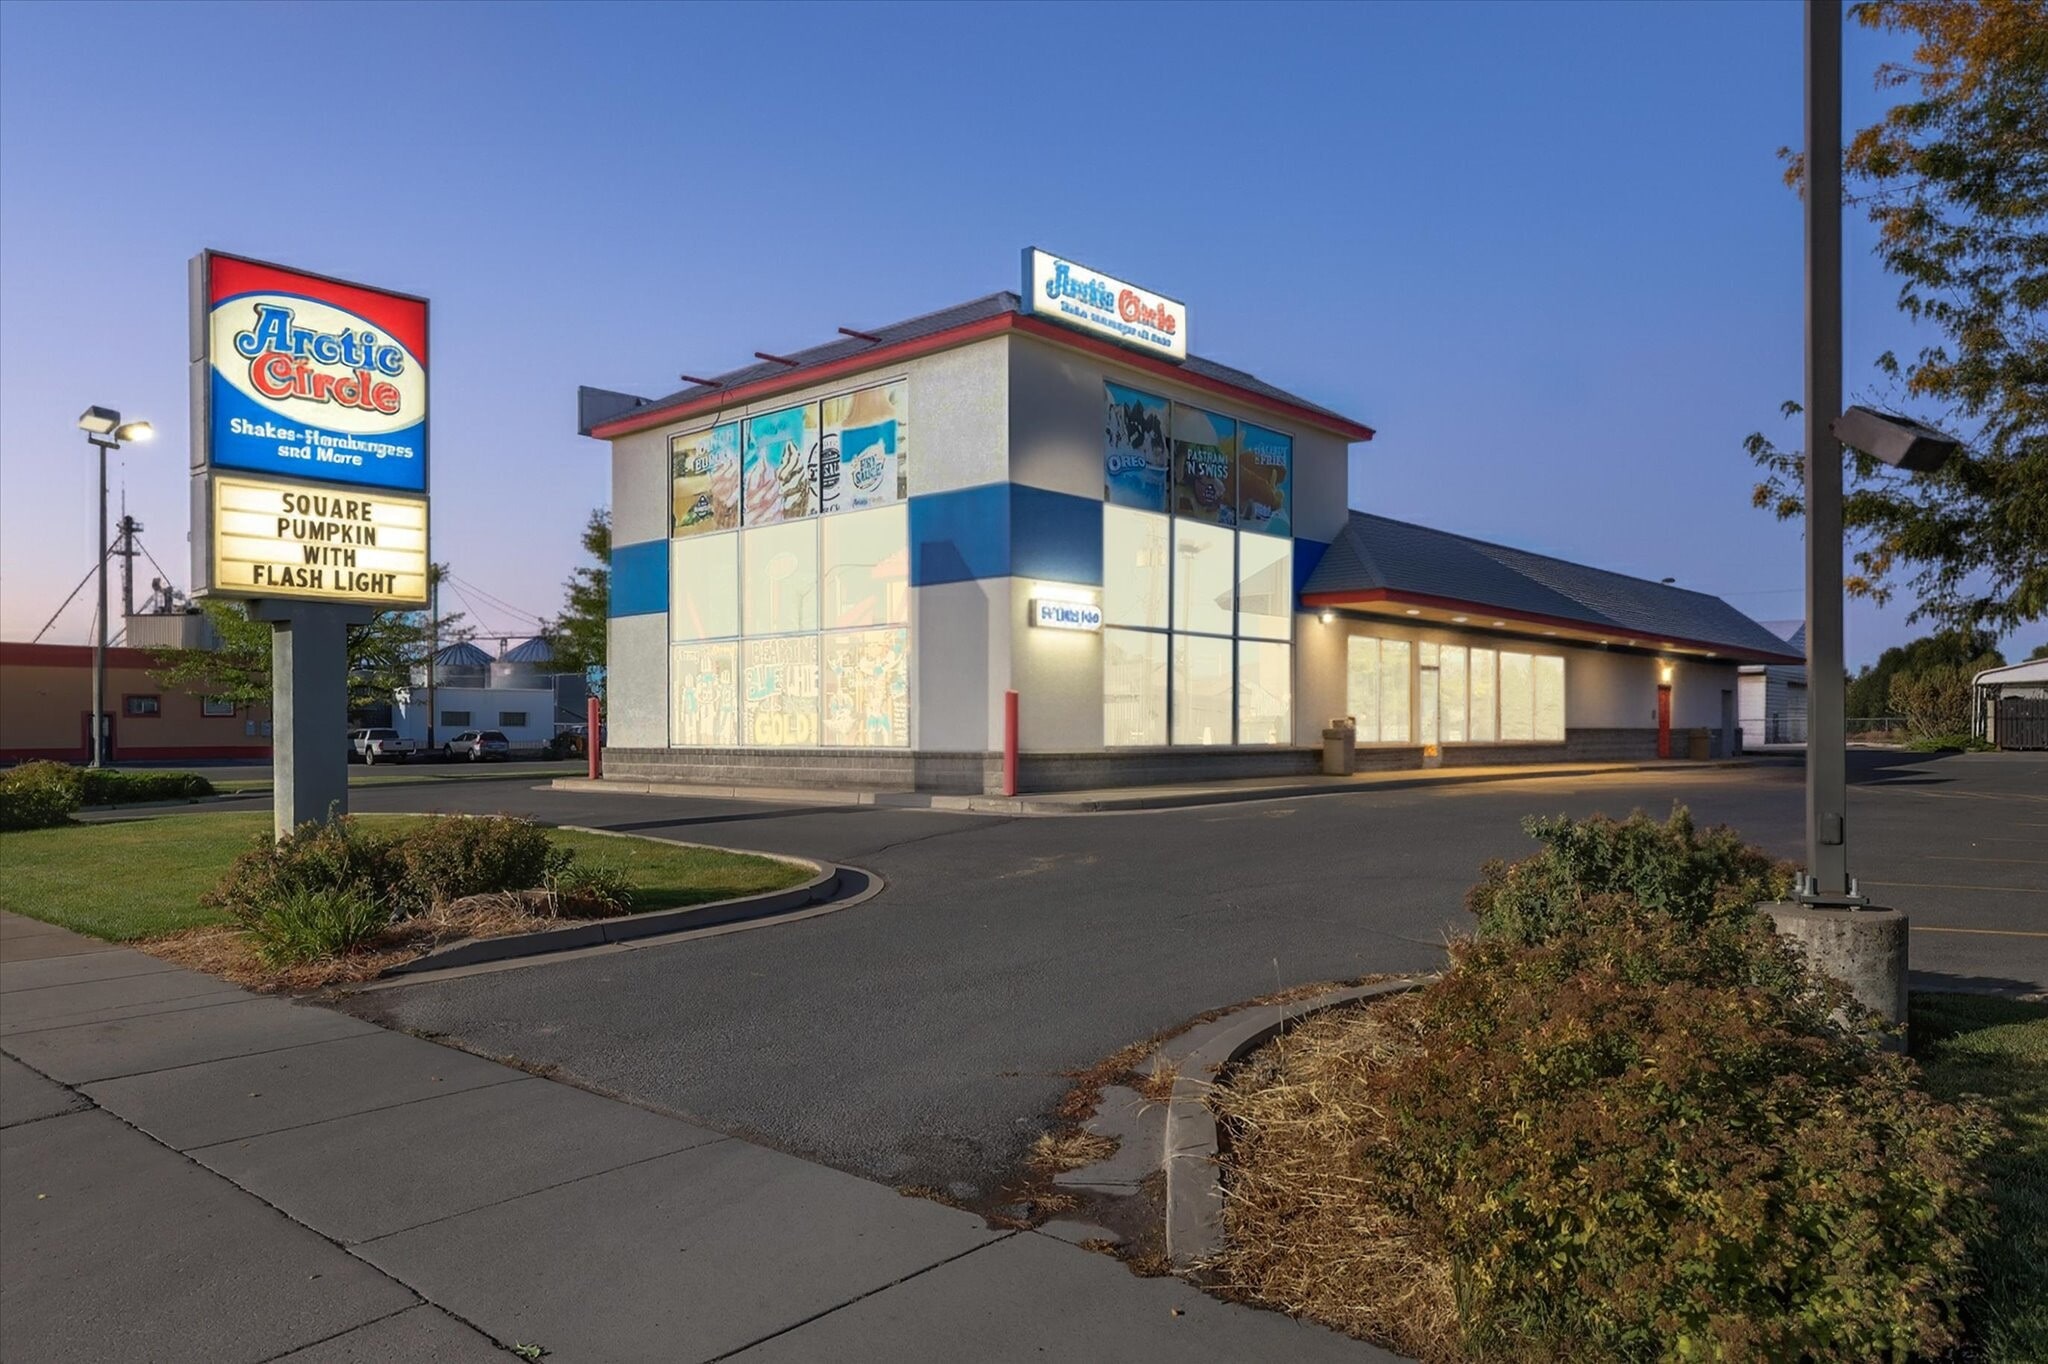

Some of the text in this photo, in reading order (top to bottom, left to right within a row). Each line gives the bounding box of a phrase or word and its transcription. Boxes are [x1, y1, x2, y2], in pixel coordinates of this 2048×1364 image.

[235, 302, 405, 377] Arctic
[248, 351, 402, 415] Circle
[316, 446, 363, 466] More
[1107, 454, 1146, 475] OREO
[1187, 448, 1229, 464] PASTRAMI
[1199, 463, 1229, 479] SWISS
[282, 493, 373, 522] SQUARE
[277, 517, 377, 546] PUMPKIN
[303, 545, 357, 568] WITH
[253, 565, 397, 595] FLASH LIGHT
